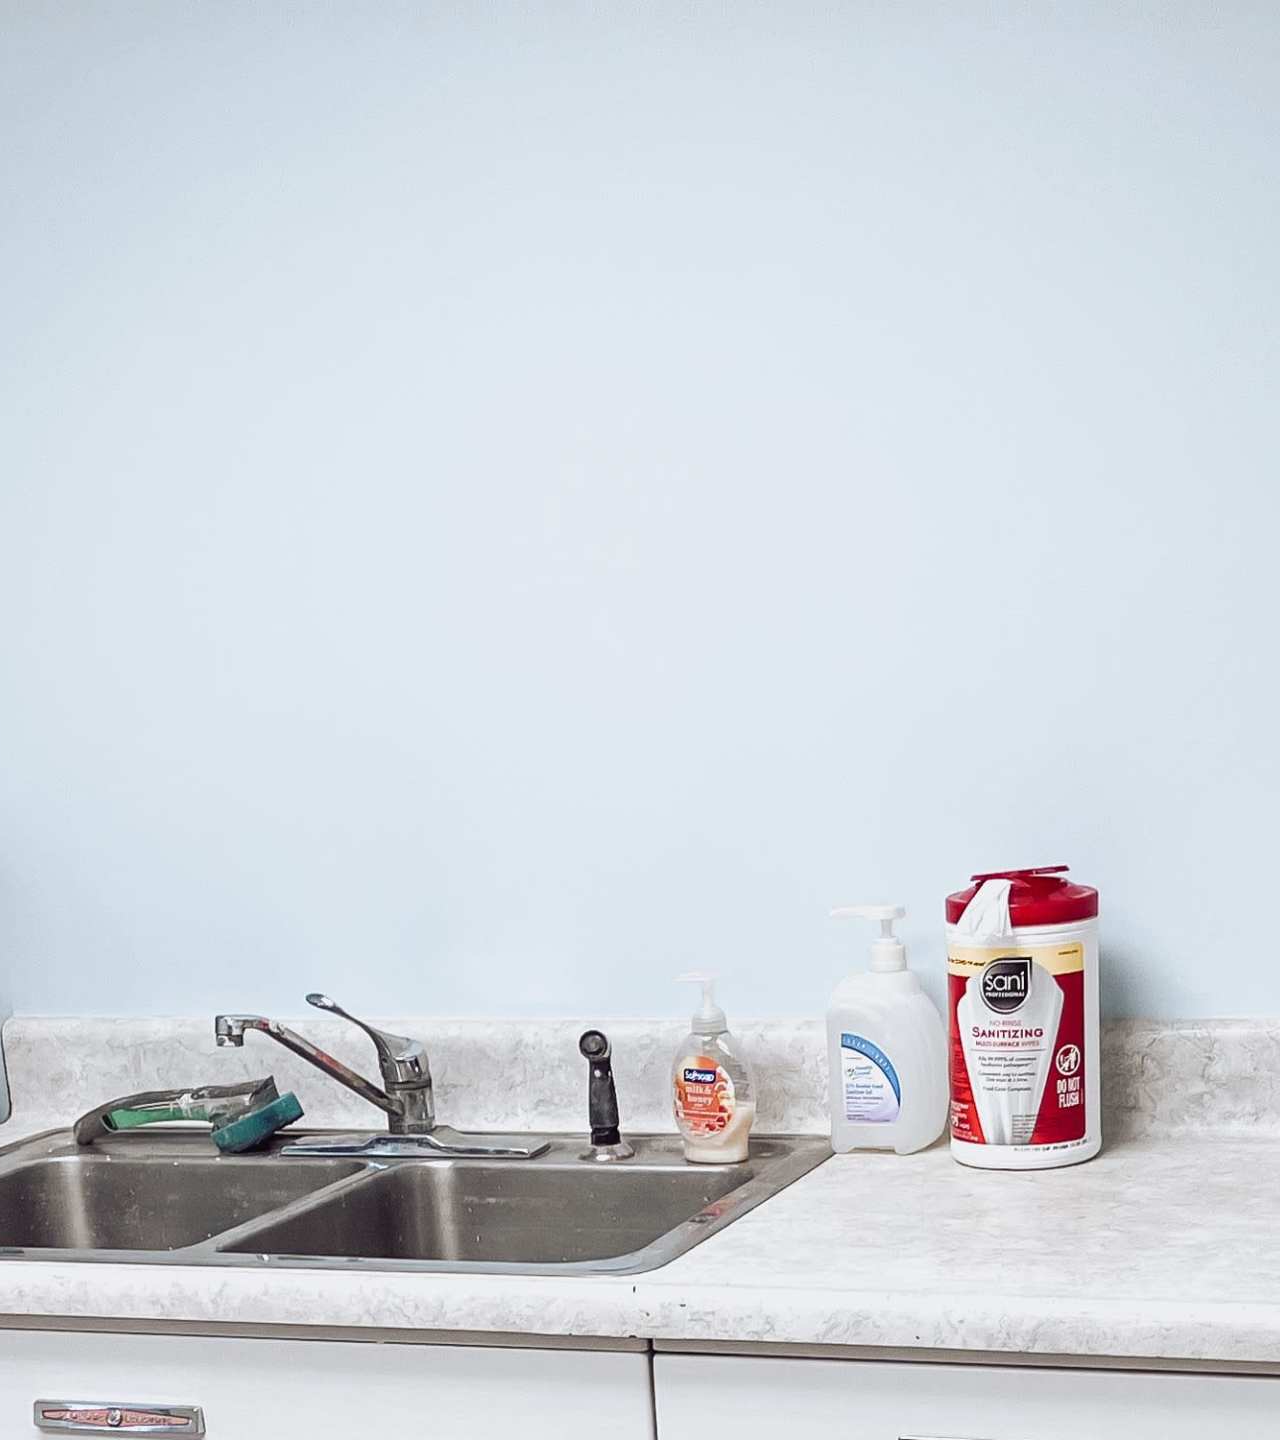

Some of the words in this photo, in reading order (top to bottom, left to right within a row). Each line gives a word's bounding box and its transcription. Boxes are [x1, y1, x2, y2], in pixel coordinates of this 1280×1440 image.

[985, 971, 1025, 991] sani
[972, 1026, 1044, 1039] SANITIZING
[1056, 1079, 1067, 1094] DO
[1067, 1076, 1080, 1091] NOT
[1058, 1091, 1080, 1108] FLUSH
